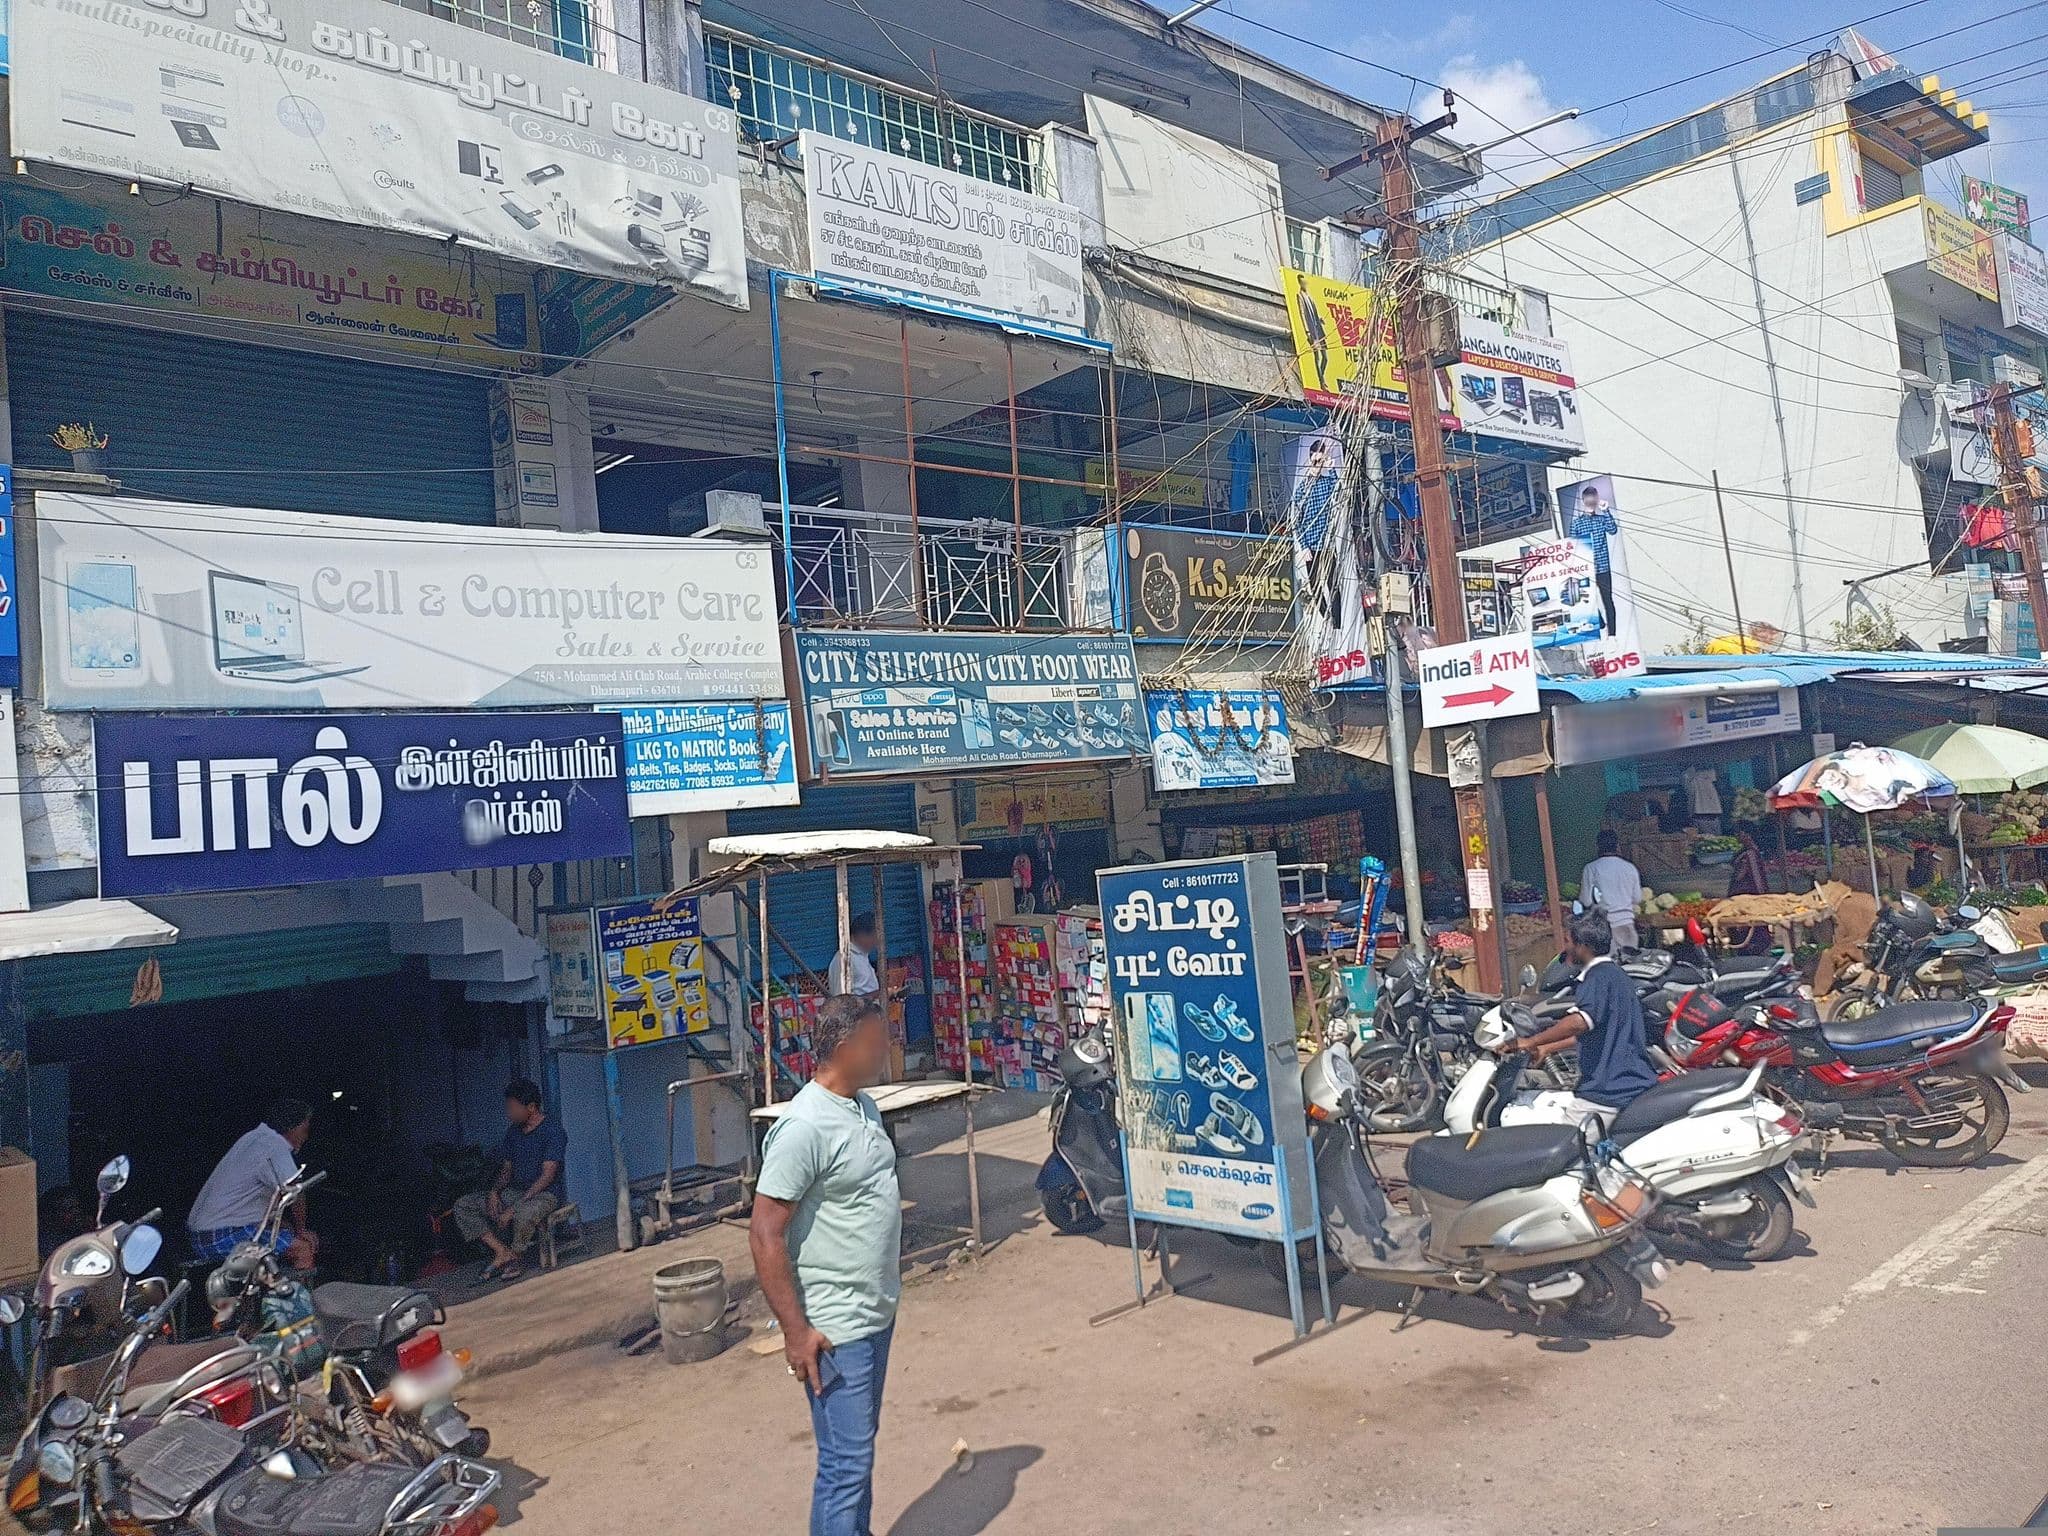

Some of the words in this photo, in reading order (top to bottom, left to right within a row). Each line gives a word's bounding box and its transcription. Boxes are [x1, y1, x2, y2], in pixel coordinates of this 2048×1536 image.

[311, 20, 592, 127] கம்ப்யூட்டர்
[611, 100, 705, 160] கேர்
[814, 146, 961, 231] KAMS
[823, 210, 881, 235] எங்களிடம்
[882, 225, 926, 248] குறைந்த
[926, 236, 983, 261] வாடகையில்
[962, 201, 1006, 240] பஸ்
[1009, 212, 1079, 259] சர்வீஸ்
[19, 214, 136, 260] செல்
[148, 238, 183, 269] &
[196, 247, 405, 307] கம்பியூட்டர்
[820, 228, 836, 245] 57
[837, 229, 854, 250] சீட்
[854, 237, 899, 260] கொண்ட
[900, 248, 922, 265] கலர்
[923, 250, 961, 274] வீடியோ
[47, 264, 113, 289] சேல்ஸ்
[134, 281, 194, 303] சர்வீஸ்
[831, 250, 872, 272] பஸ்கள்
[872, 261, 930, 288] வாடகைக்கு
[930, 272, 981, 297] கிடைக்கும்.
[304, 310, 386, 332] ஆன்லைன்
[388, 321, 461, 345] வேலைகள்
[1467, 352, 1489, 368] LAPTOP
[1495, 359, 1519, 373] DESKTOP
[1504, 345, 1562, 373] COMPUTERS
[735, 551, 758, 570] C3
[1187, 556, 1234, 598] K.S.
[1526, 572, 1548, 584] SALES
[311, 566, 404, 617] Cell
[418, 584, 446, 617] &
[461, 573, 665, 629] Computer
[677, 581, 765, 622] Care
[555, 632, 634, 659] Sales
[646, 641, 663, 658] &
[671, 632, 768, 659] Service
[801, 638, 817, 648] Cell
[1077, 641, 1090, 650] Cell
[805, 650, 860, 684] CITY
[865, 650, 984, 683] SELECTION
[985, 654, 1030, 682] CITY
[1031, 653, 1079, 681] FOOT
[1081, 653, 1134, 681] WEAR
[1317, 649, 1367, 682] BOYS
[1488, 648, 1531, 674] ATM
[1592, 651, 1641, 678] BOYS
[534, 670, 555, 683] 75/8
[564, 669, 618, 683] Mohammed
[619, 670, 634, 682] Ali
[684, 668, 712, 680] Arabic
[713, 668, 743, 682] College
[745, 668, 778, 682] Complex
[591, 684, 645, 698] Dharmapuri
[650, 684, 682, 696] 636701
[711, 684, 744, 696] 99441
[862, 692, 885, 701] oppo
[655, 706, 726, 738] Publishing
[727, 705, 785, 735] Comany
[849, 709, 891, 728] Sales
[892, 708, 906, 726] &
[906, 708, 958, 726] Service
[857, 730, 874, 742] All
[876, 729, 915, 741] Online
[916, 727, 950, 739] Brand
[636, 740, 662, 761] LKG
[664, 741, 680, 759] To
[681, 739, 727, 759] MATRIC
[867, 744, 918, 758] Available
[920, 743, 947, 754] Here
[922, 755, 968, 766] Mohammed
[968, 754, 979, 762] Ali
[980, 752, 998, 761] Club
[999, 751, 1021, 762] Road,
[639, 760, 662, 778] Belts,
[663, 760, 683, 777] Ties,
[683, 758, 713, 776] Badges,
[714, 758, 739, 774] Socks,
[122, 725, 384, 857] பால்
[395, 736, 620, 792] இன்ஜினியரிங்
[630, 778, 680, 793] 9842762160
[685, 777, 710, 789] 77085
[711, 776, 735, 788] 85932
[1162, 876, 1180, 889] Cell
[1186, 871, 1240, 888] 8610177723
[1112, 888, 1241, 940] சிட்டி
[1114, 947, 1161, 987] புட்
[1167, 938, 1248, 977] வேர்
[1177, 1160, 1274, 1187] செலக்ஷன்
